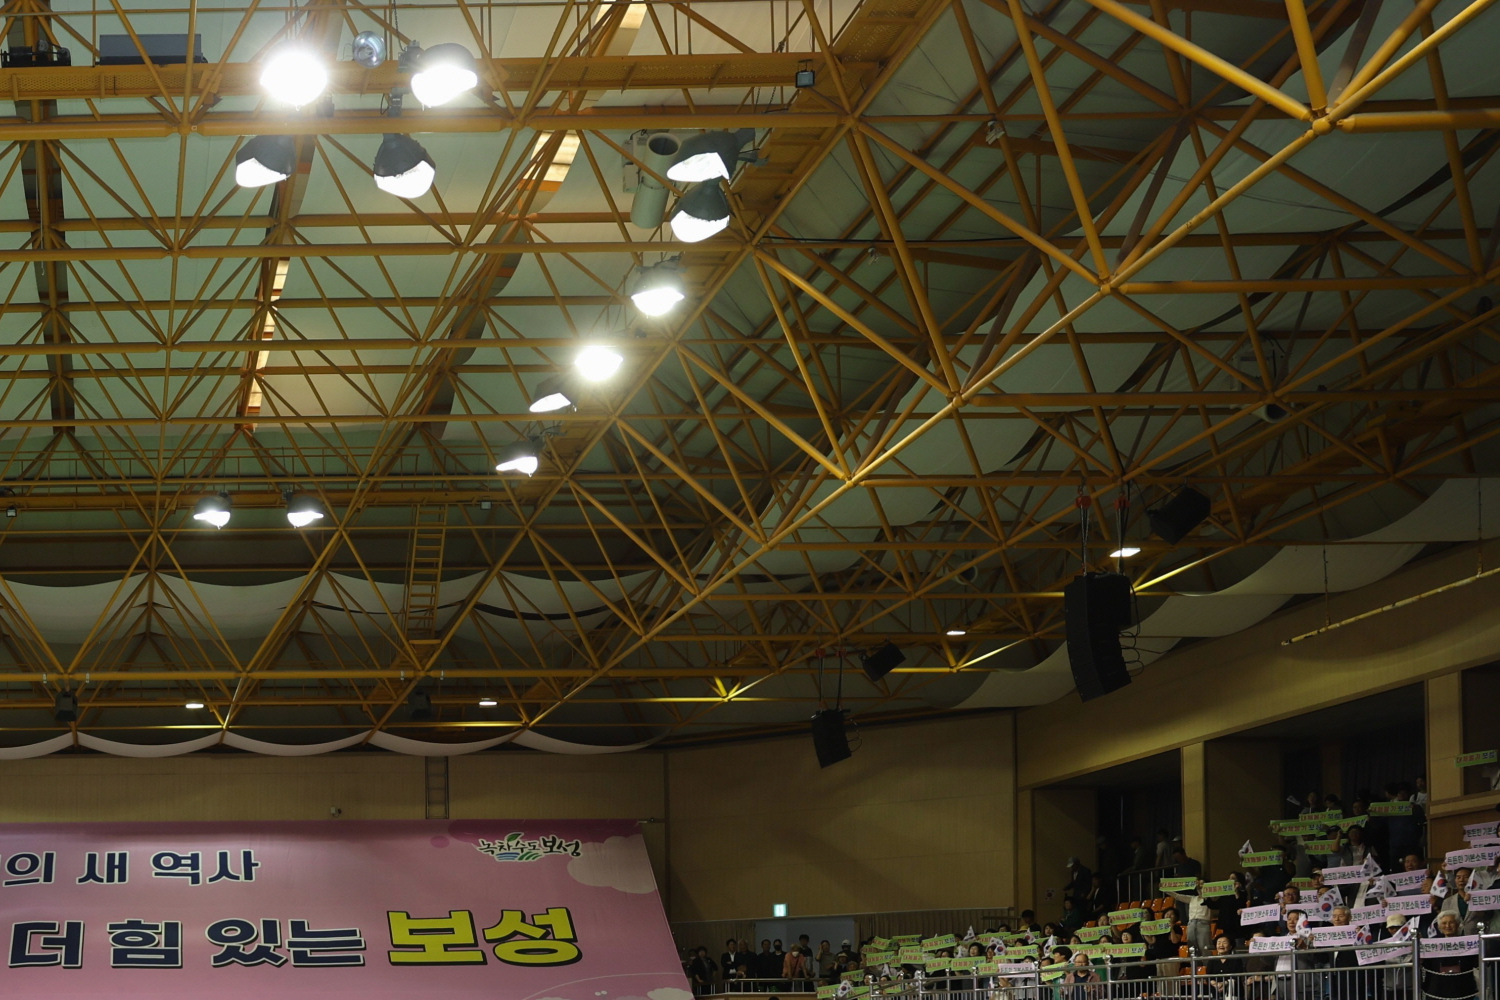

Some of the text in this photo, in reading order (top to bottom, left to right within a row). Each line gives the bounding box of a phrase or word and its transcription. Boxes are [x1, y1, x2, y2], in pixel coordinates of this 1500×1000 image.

[479, 836, 581, 856] 녹차수도 보성
[77, 850, 127, 885] 새
[151, 849, 260, 885] 역사
[8, 920, 84, 969] 더
[107, 920, 183, 969] 힘
[206, 918, 364, 967] 있는
[386, 908, 582, 967] 보성
